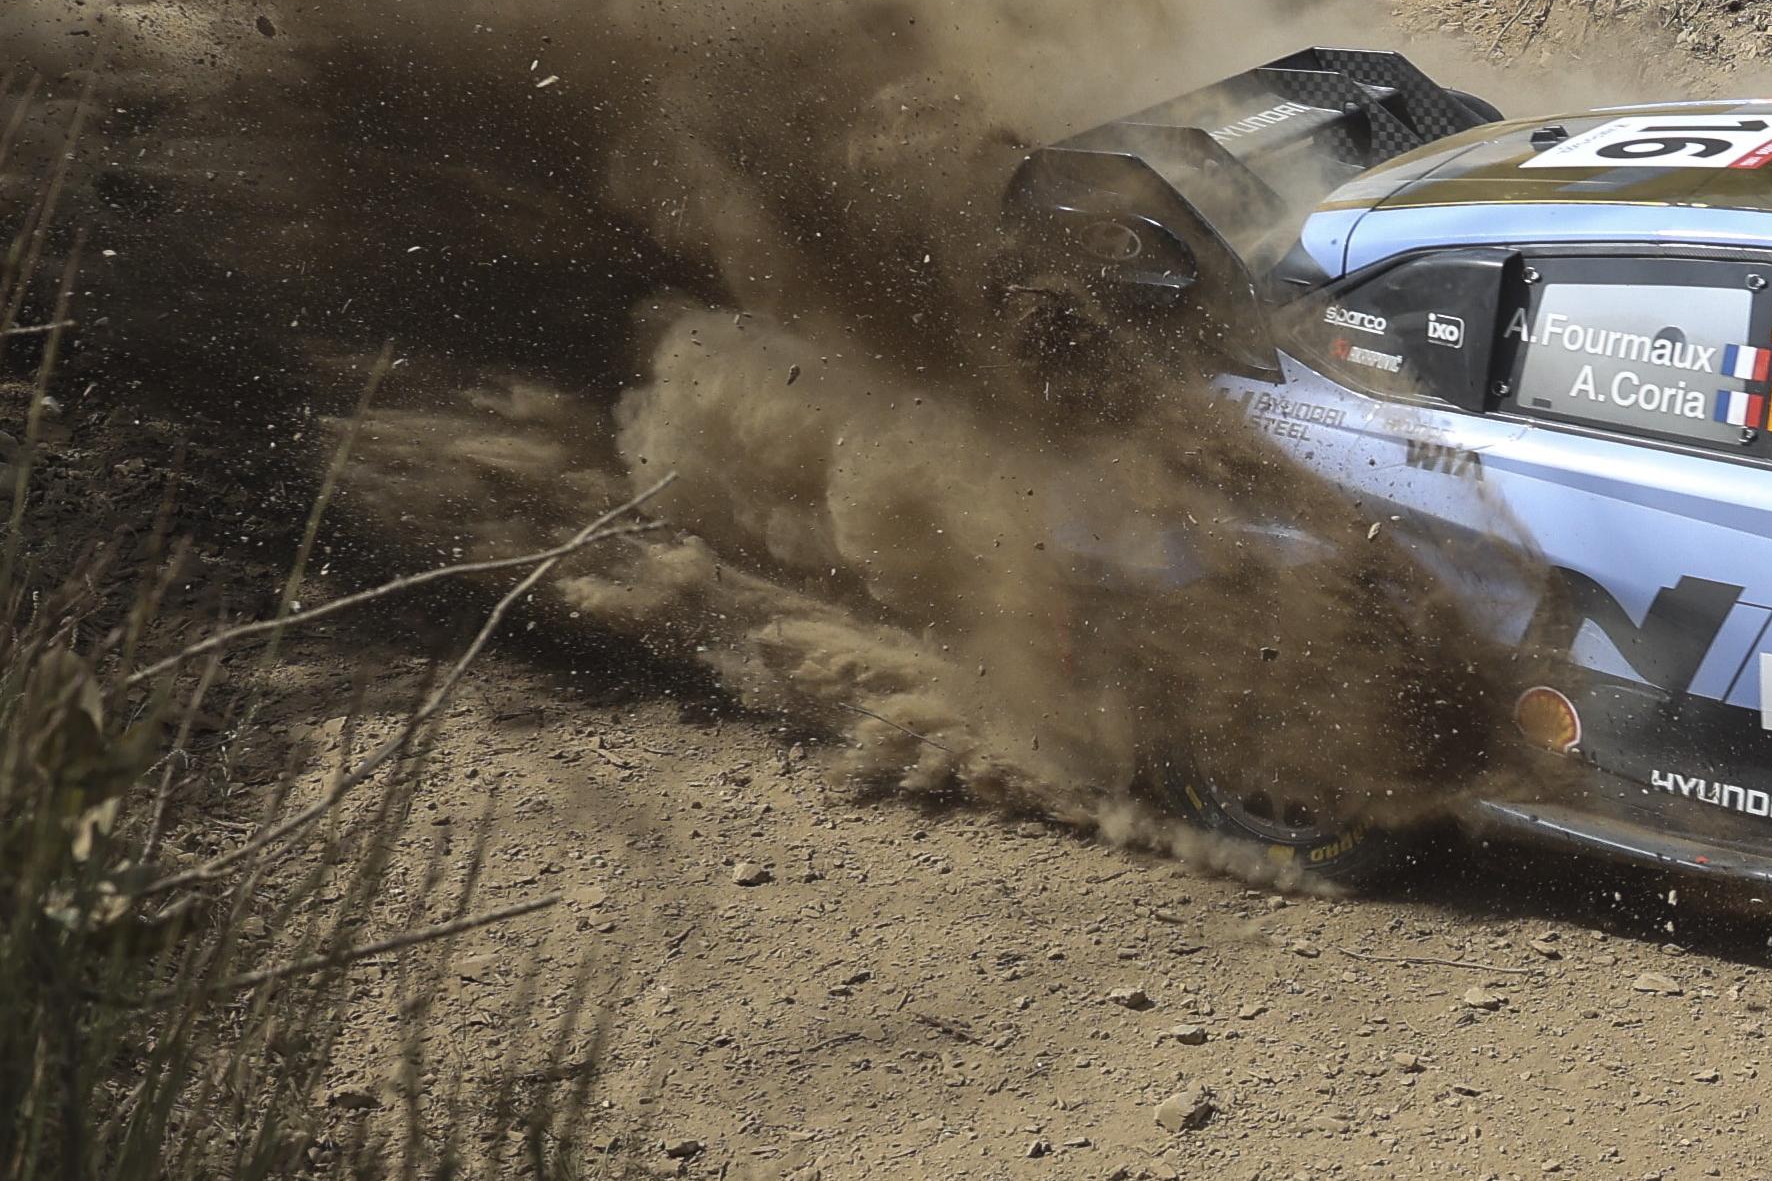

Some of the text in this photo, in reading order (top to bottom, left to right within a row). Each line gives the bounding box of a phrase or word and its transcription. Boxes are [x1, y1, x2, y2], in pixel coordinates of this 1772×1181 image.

[1325, 305, 1387, 334] sparco
[1541, 312, 1717, 373] Fourmaux
[1610, 371, 1706, 419] Coria
